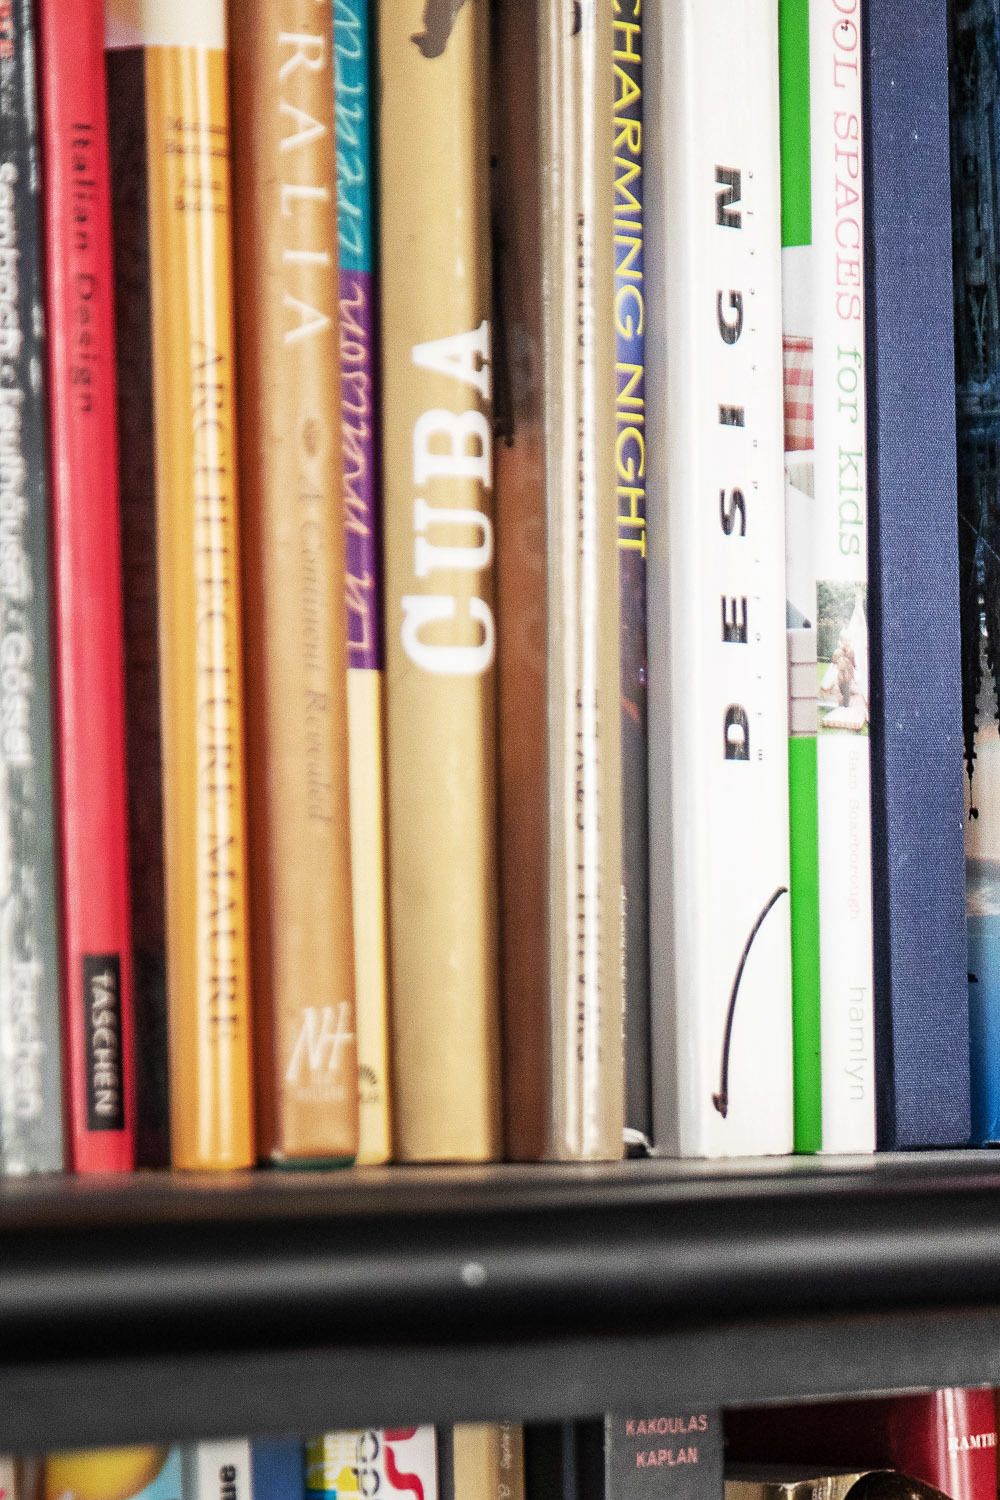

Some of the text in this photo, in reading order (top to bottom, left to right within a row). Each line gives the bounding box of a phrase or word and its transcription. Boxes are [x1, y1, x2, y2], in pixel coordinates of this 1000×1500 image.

[277, 2, 331, 344] RALIA
[833, 110, 862, 321] SPACES
[70, 121, 98, 414] Italian Design
[611, 0, 647, 559] HARMING NIGHT
[714, 164, 750, 761] DESIGN
[836, 345, 863, 423] for
[401, 320, 497, 676] CUBA
[836, 446, 864, 556] kids
[91, 970, 117, 1116] TASCHEN
[845, 986, 868, 1101] hamlyn
[625, 1414, 708, 1436] KAKOULAS
[636, 1447, 699, 1468] KAPLAN
